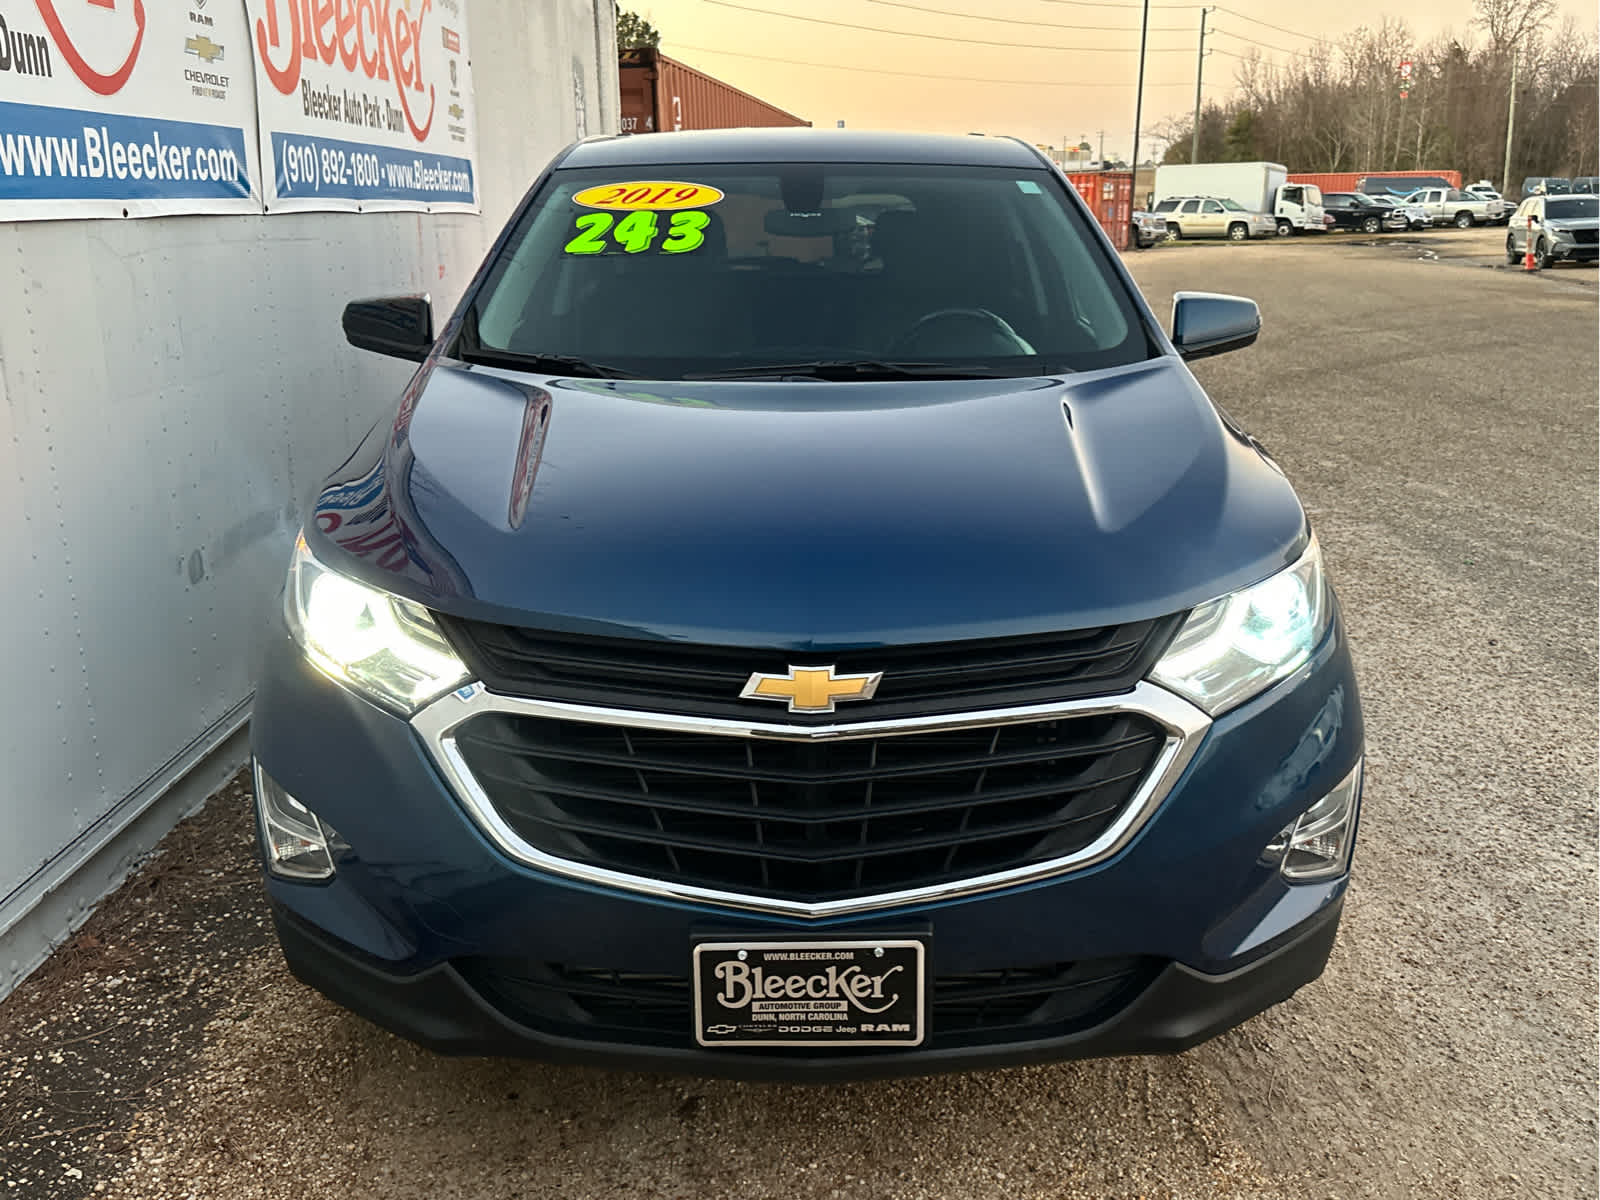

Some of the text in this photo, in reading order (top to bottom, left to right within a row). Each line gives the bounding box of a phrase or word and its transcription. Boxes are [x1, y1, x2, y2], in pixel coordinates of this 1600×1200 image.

[189, 12, 214, 26] RAM
[0, 13, 52, 77] Dunn
[184, 69, 229, 87] CHEVROLET
[301, 78, 405, 133] Bleecker Auto Park Dunn
[0, 126, 239, 182] www.Bleecker.com
[282, 139, 470, 193] (910) 892-1800 www.Bleecker.com
[596, 187, 699, 205] 2019
[564, 210, 711, 255] 243
[763, 952, 855, 961] WWW.BLEECKER.COM
[714, 960, 904, 1014] Bleecker
[759, 1002, 842, 1010] AUTOMOTIVE GROUP
[752, 1012, 849, 1022] DUNN, NORTH CAROLINA
[778, 1025, 833, 1033] DODGE
[835, 1025, 857, 1034] Jeep
[860, 1023, 911, 1032] RAM
